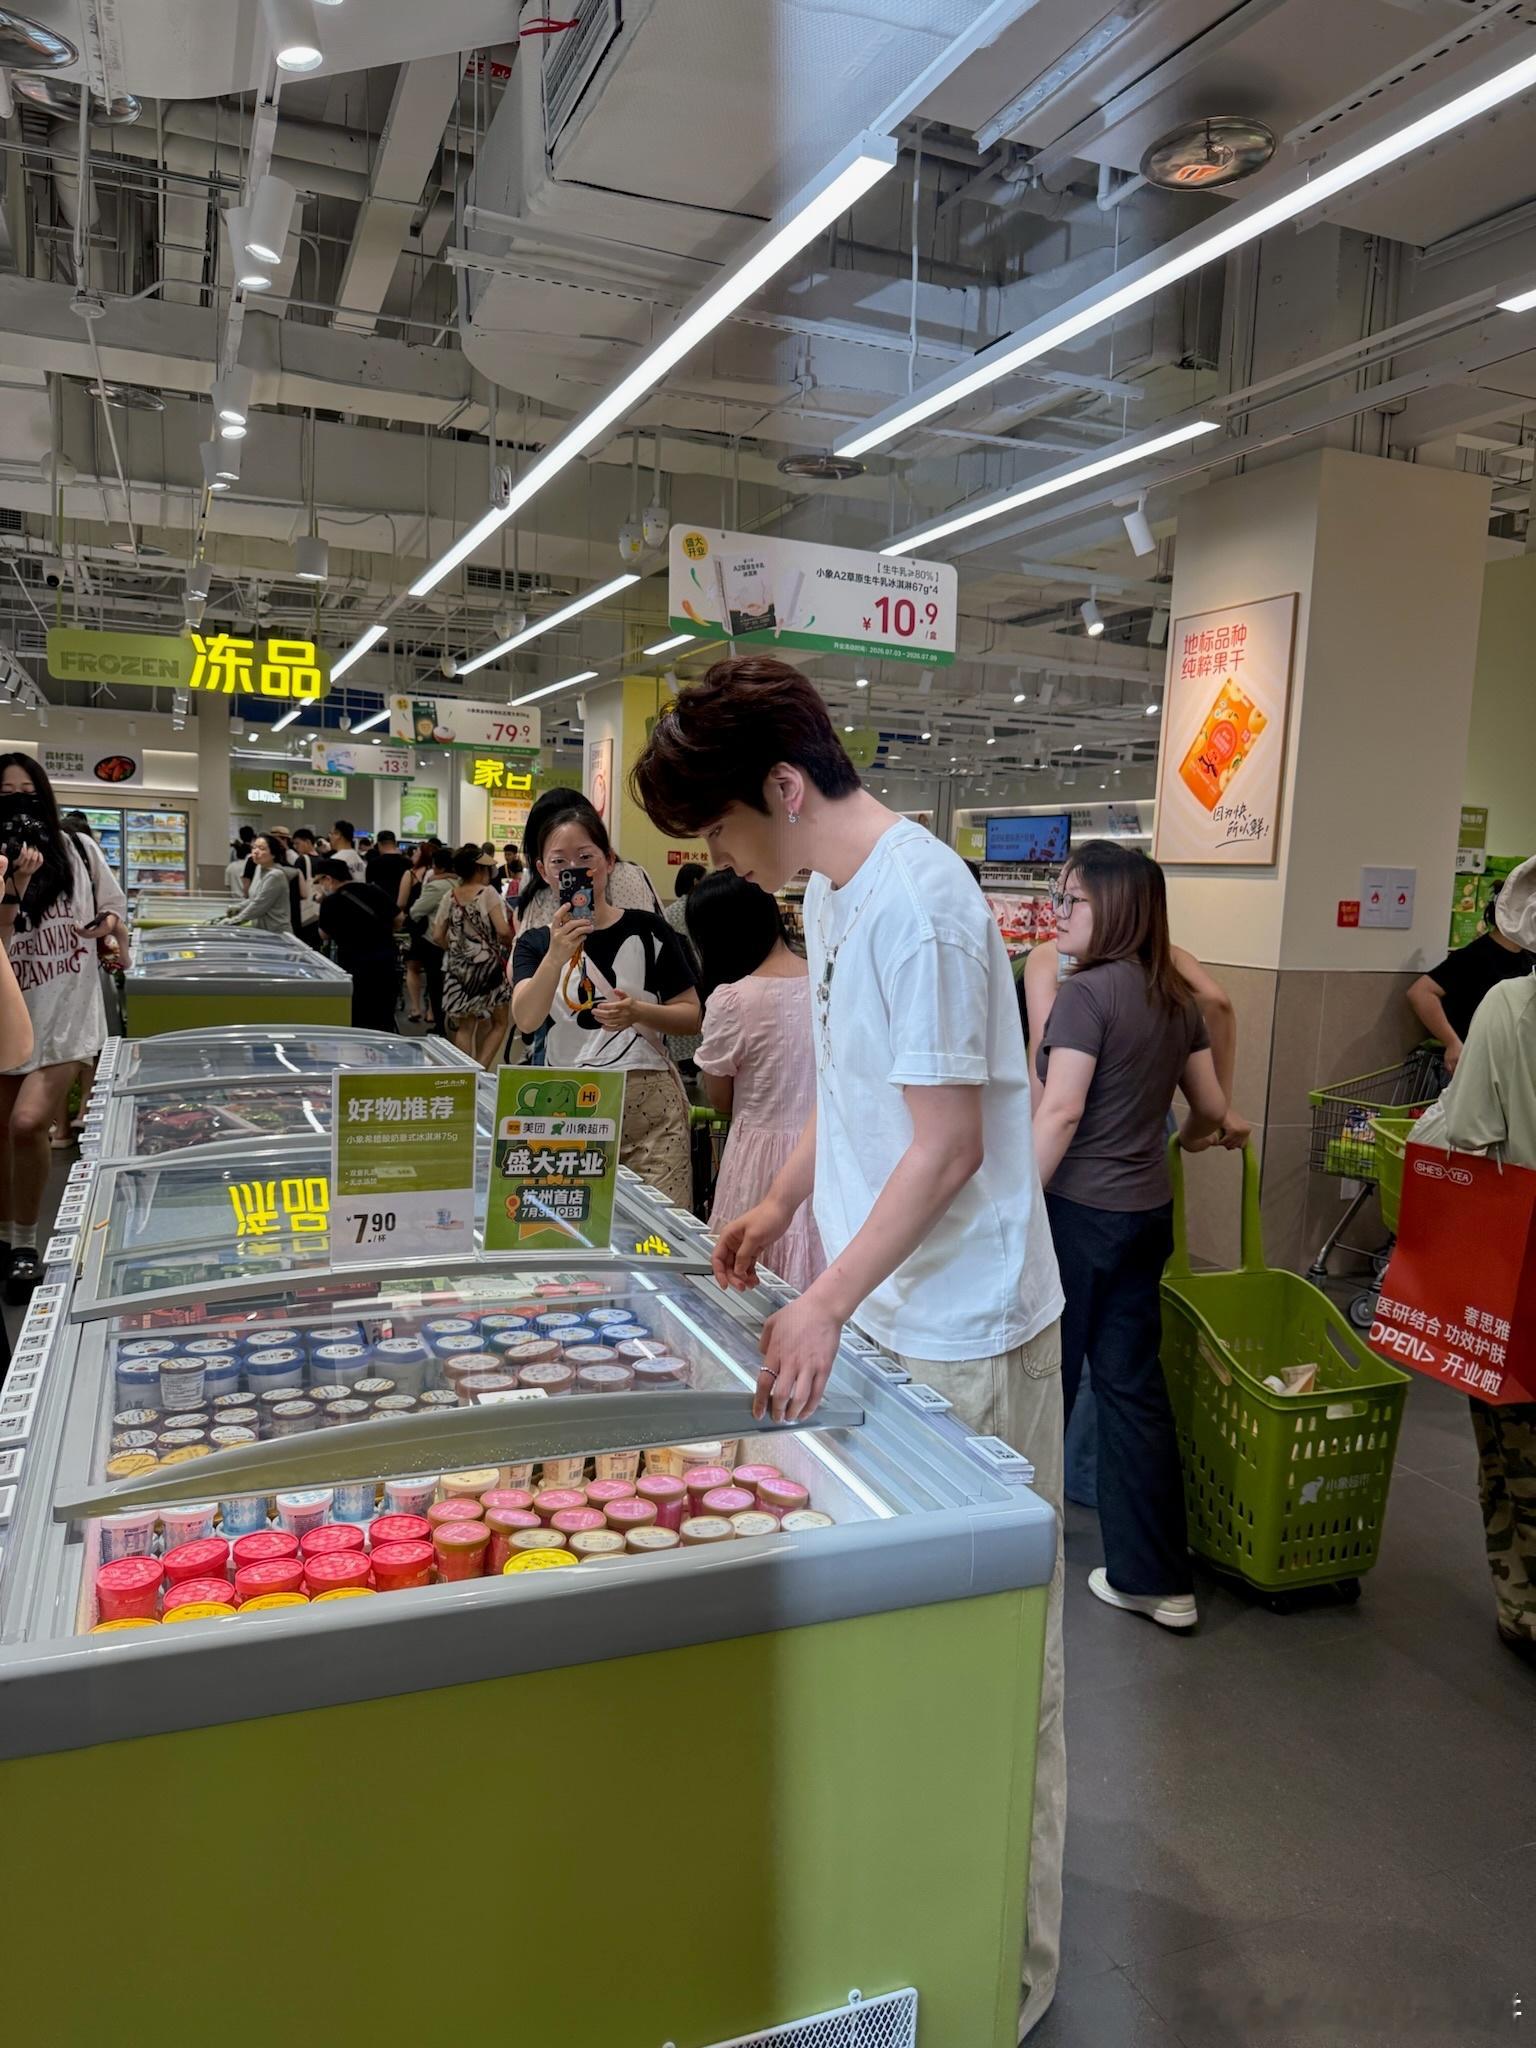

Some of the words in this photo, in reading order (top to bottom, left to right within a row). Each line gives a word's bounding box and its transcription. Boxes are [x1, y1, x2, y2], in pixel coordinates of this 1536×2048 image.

[1183, 623, 1247, 655] 地标品种
[60, 651, 180, 679] FROZEN
[189, 633, 321, 699] 冻品
[1181, 649, 1245, 680] 纯粹果干
[33, 923, 78, 957] ALWAYS
[347, 1096, 454, 1123] 好物推荐
[582, 1091, 596, 1102] Hi
[522, 1122, 545, 1134] 美团
[566, 1122, 609, 1135] 小象超市
[505, 1149, 603, 1176] 盛大开业
[522, 1188, 584, 1206] 杭州首店
[567, 1207, 581, 1217] B1
[1375, 1296, 1442, 1337] 医研结合
[1444, 1322, 1507, 1367] 功效护肤
[1464, 1305, 1511, 1342] 奢思雅
[1441, 1351, 1503, 1397] 开业啦
